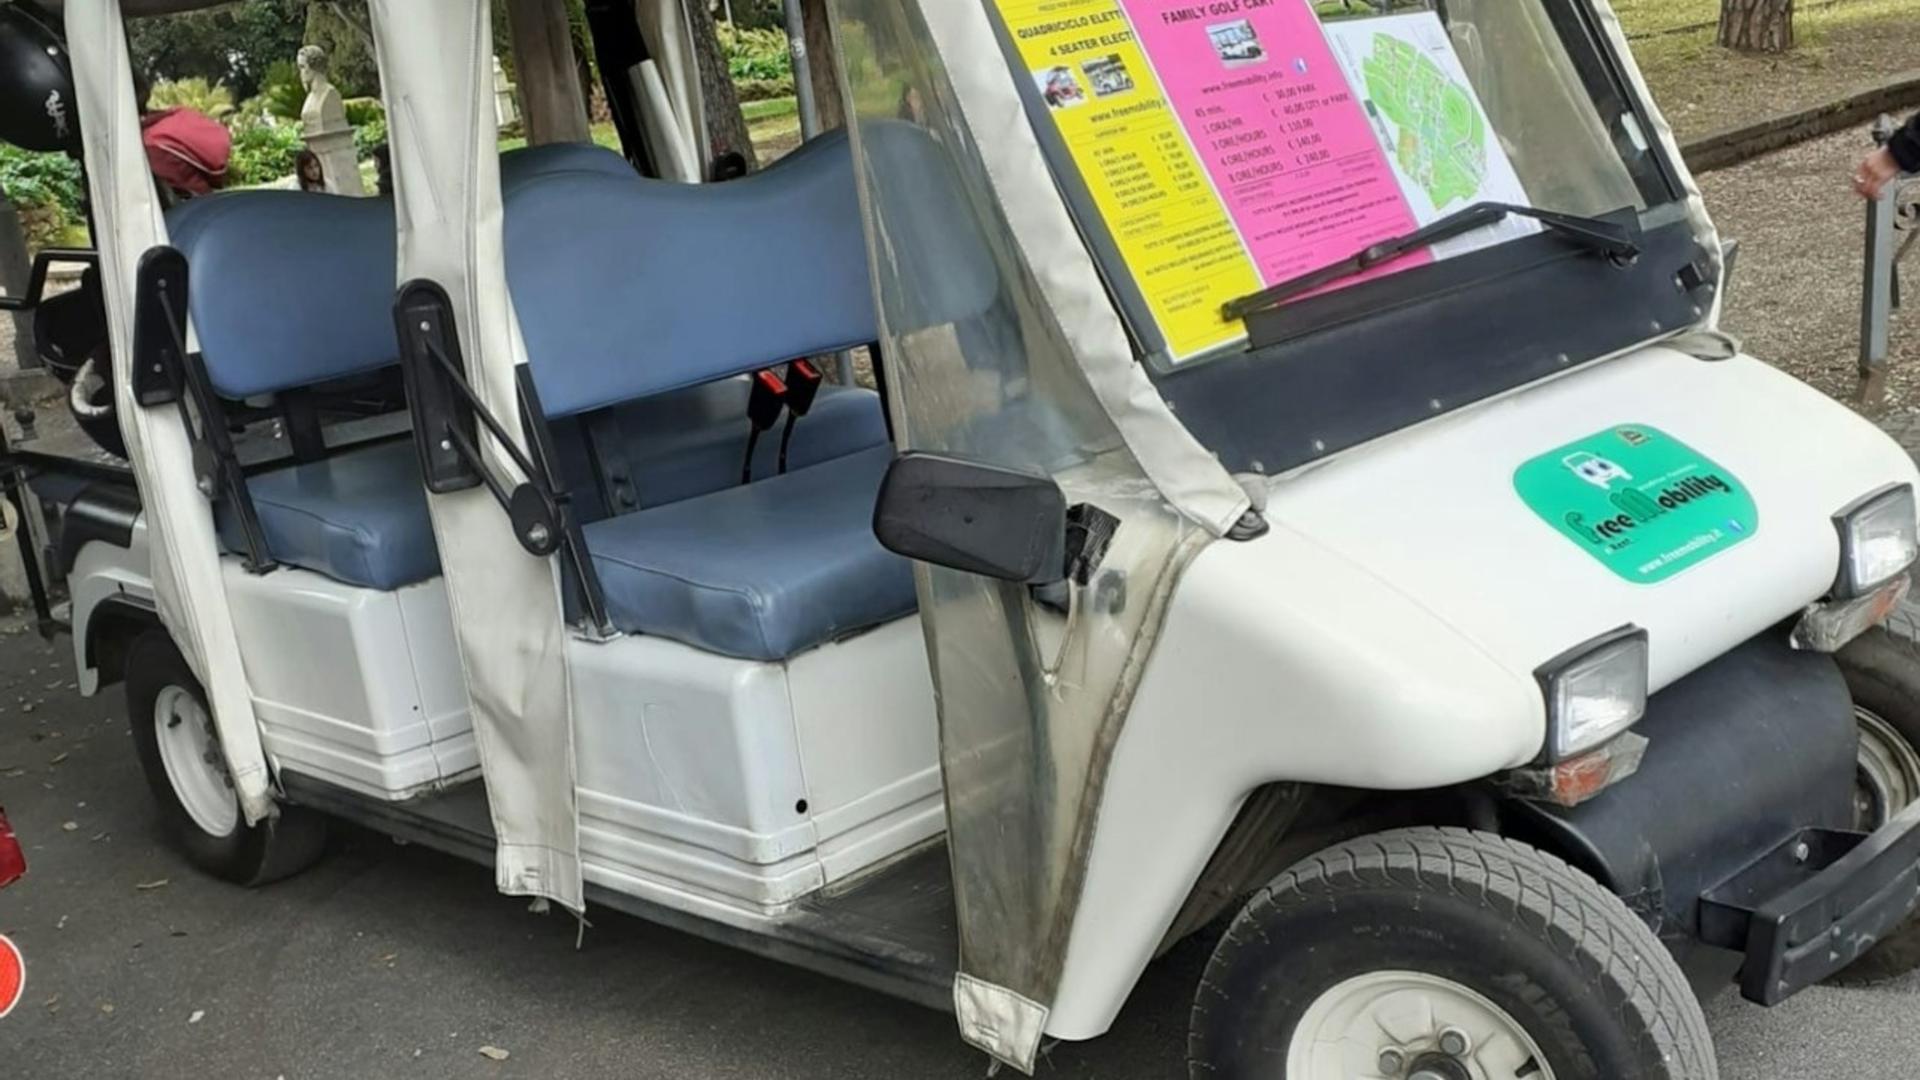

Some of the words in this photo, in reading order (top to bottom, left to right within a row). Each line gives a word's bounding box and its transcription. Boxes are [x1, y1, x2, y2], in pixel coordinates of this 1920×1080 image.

[1161, 7, 1207, 25] FAMILY
[1209, 2, 1240, 17] GOLF
[1050, 47, 1057, 56] 4
[1058, 38, 1099, 55] SEATER
[1330, 92, 1349, 103] PARK
